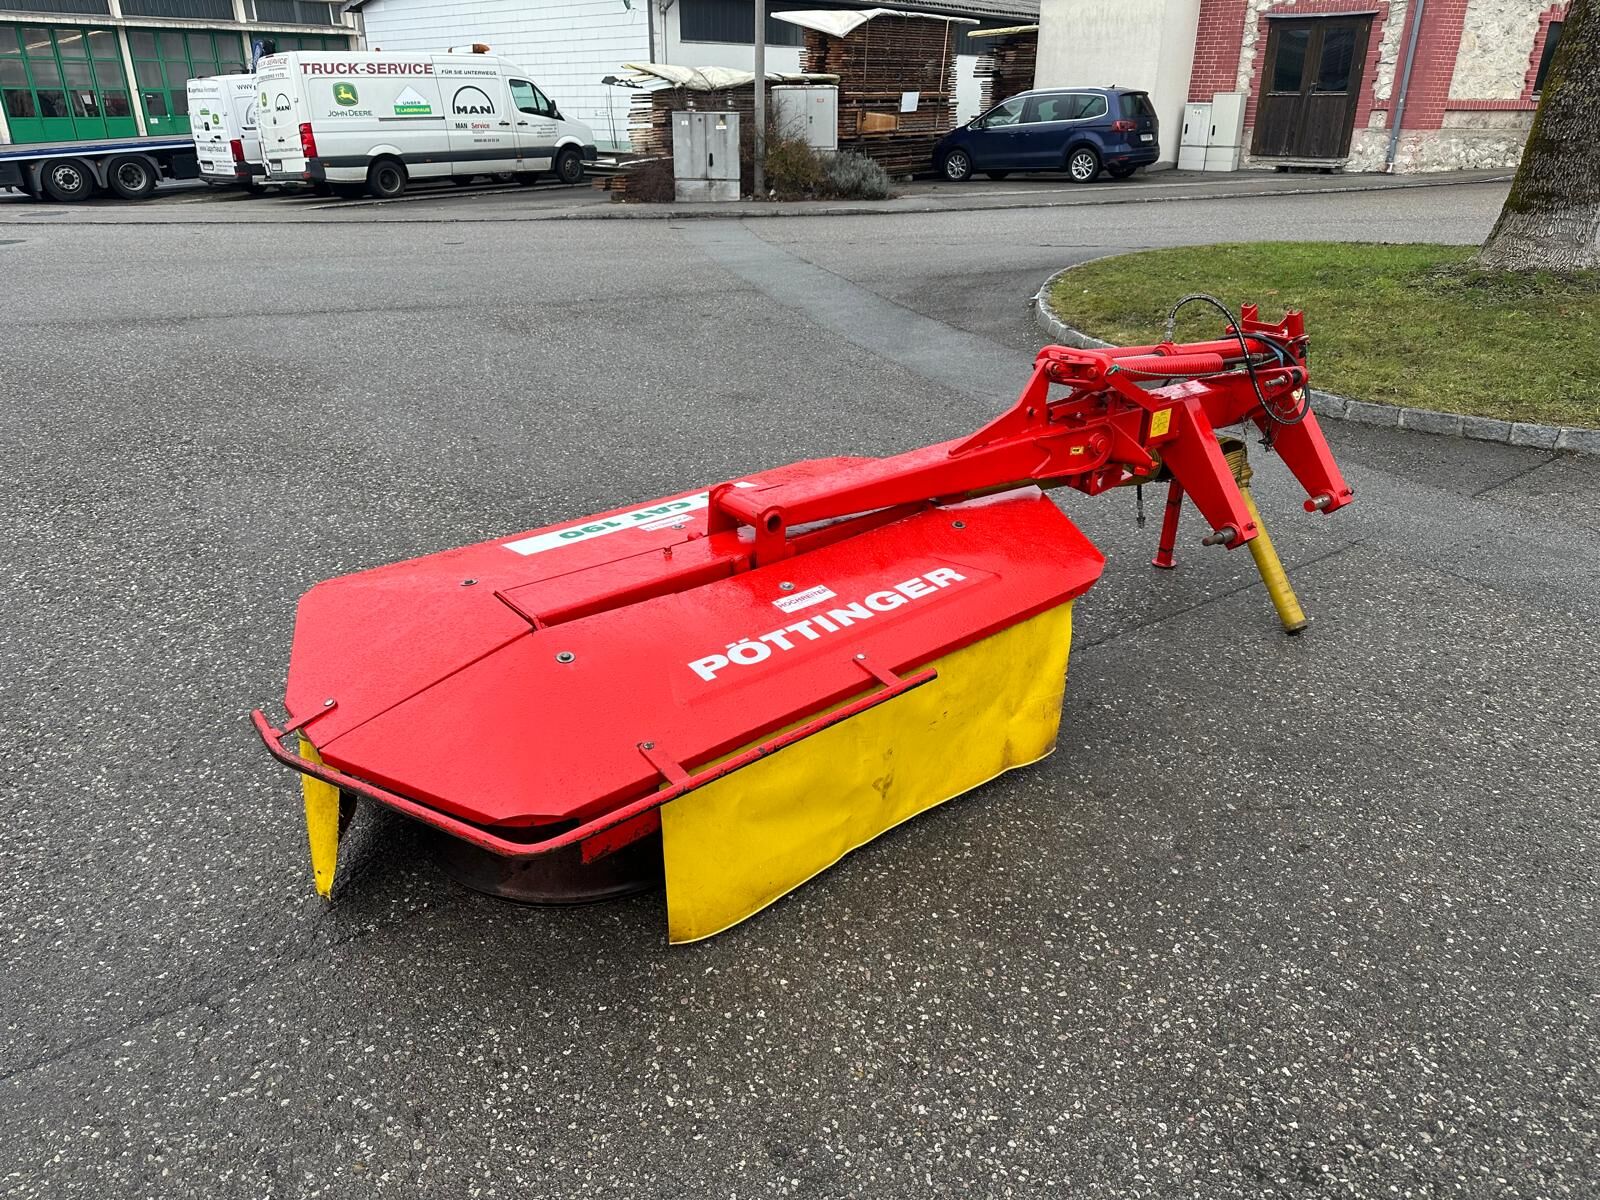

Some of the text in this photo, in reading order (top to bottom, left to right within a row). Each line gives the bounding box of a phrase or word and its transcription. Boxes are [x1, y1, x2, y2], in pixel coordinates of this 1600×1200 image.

[300, 63, 433, 75] TRUCK-SERVICE
[328, 109, 374, 117] JOHN DEERE
[456, 105, 491, 115] MAN
[631, 501, 692, 521] CAT
[559, 520, 622, 539] 190
[778, 587, 829, 608] HOCHREITER
[687, 567, 967, 682] PÖTTINGER
